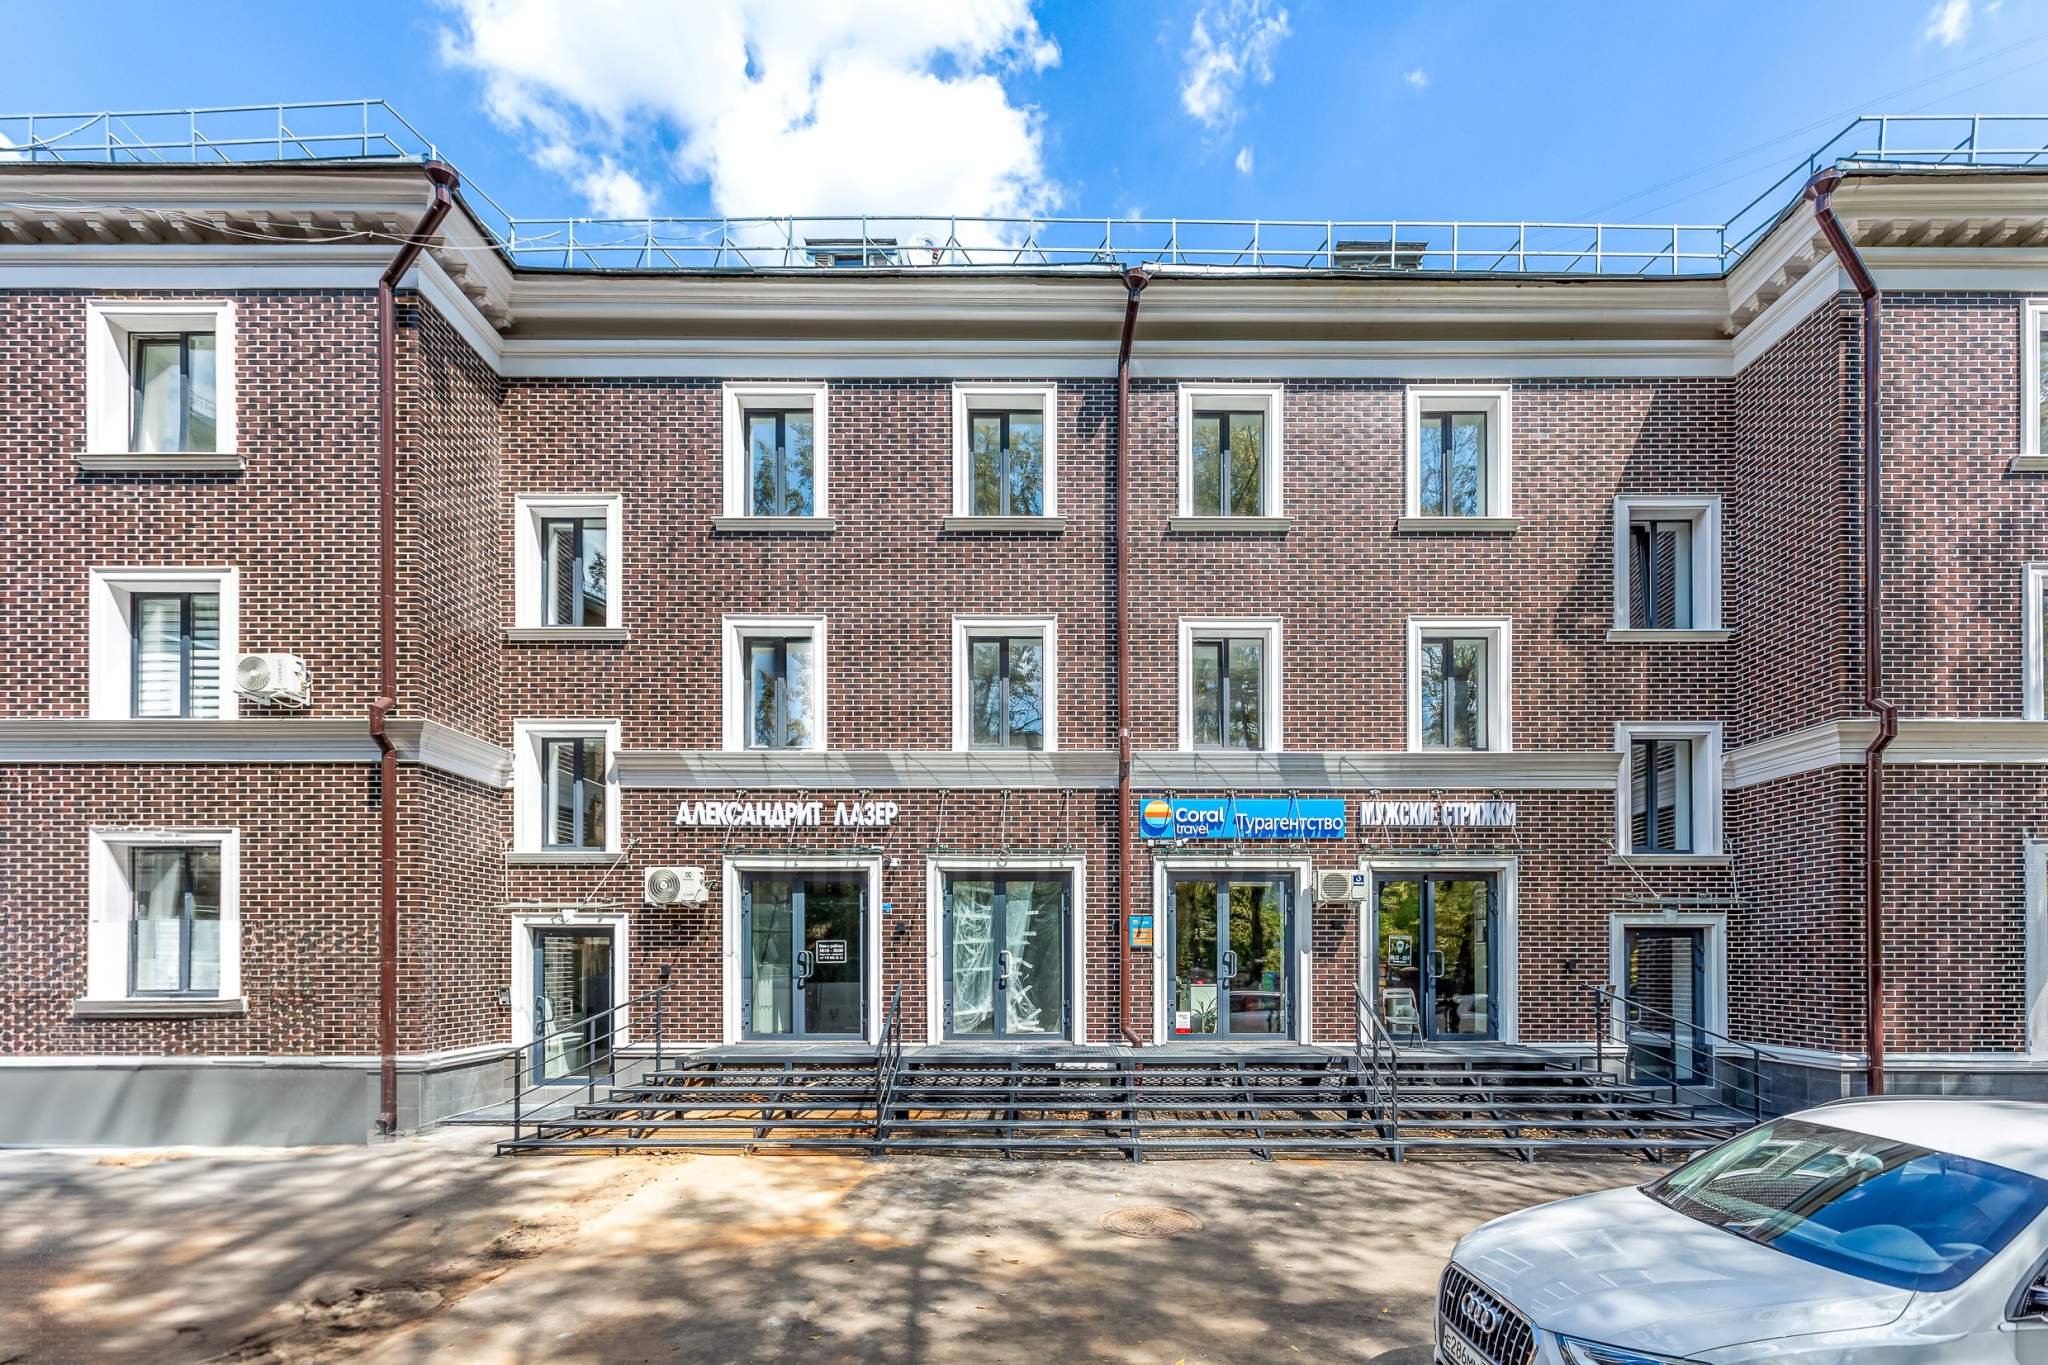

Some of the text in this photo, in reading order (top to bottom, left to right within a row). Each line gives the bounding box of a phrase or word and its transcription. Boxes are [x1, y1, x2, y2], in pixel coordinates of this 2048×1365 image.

[675, 801, 898, 828] АЛЕКСАНДРИТ ЛАЗЕР
[1175, 807, 1224, 823] Coral
[1236, 813, 1343, 834] Турагентство
[1360, 802, 1516, 826] МУЖСКИЕ СТРИЖКИ
[1176, 823, 1209, 834] travel
